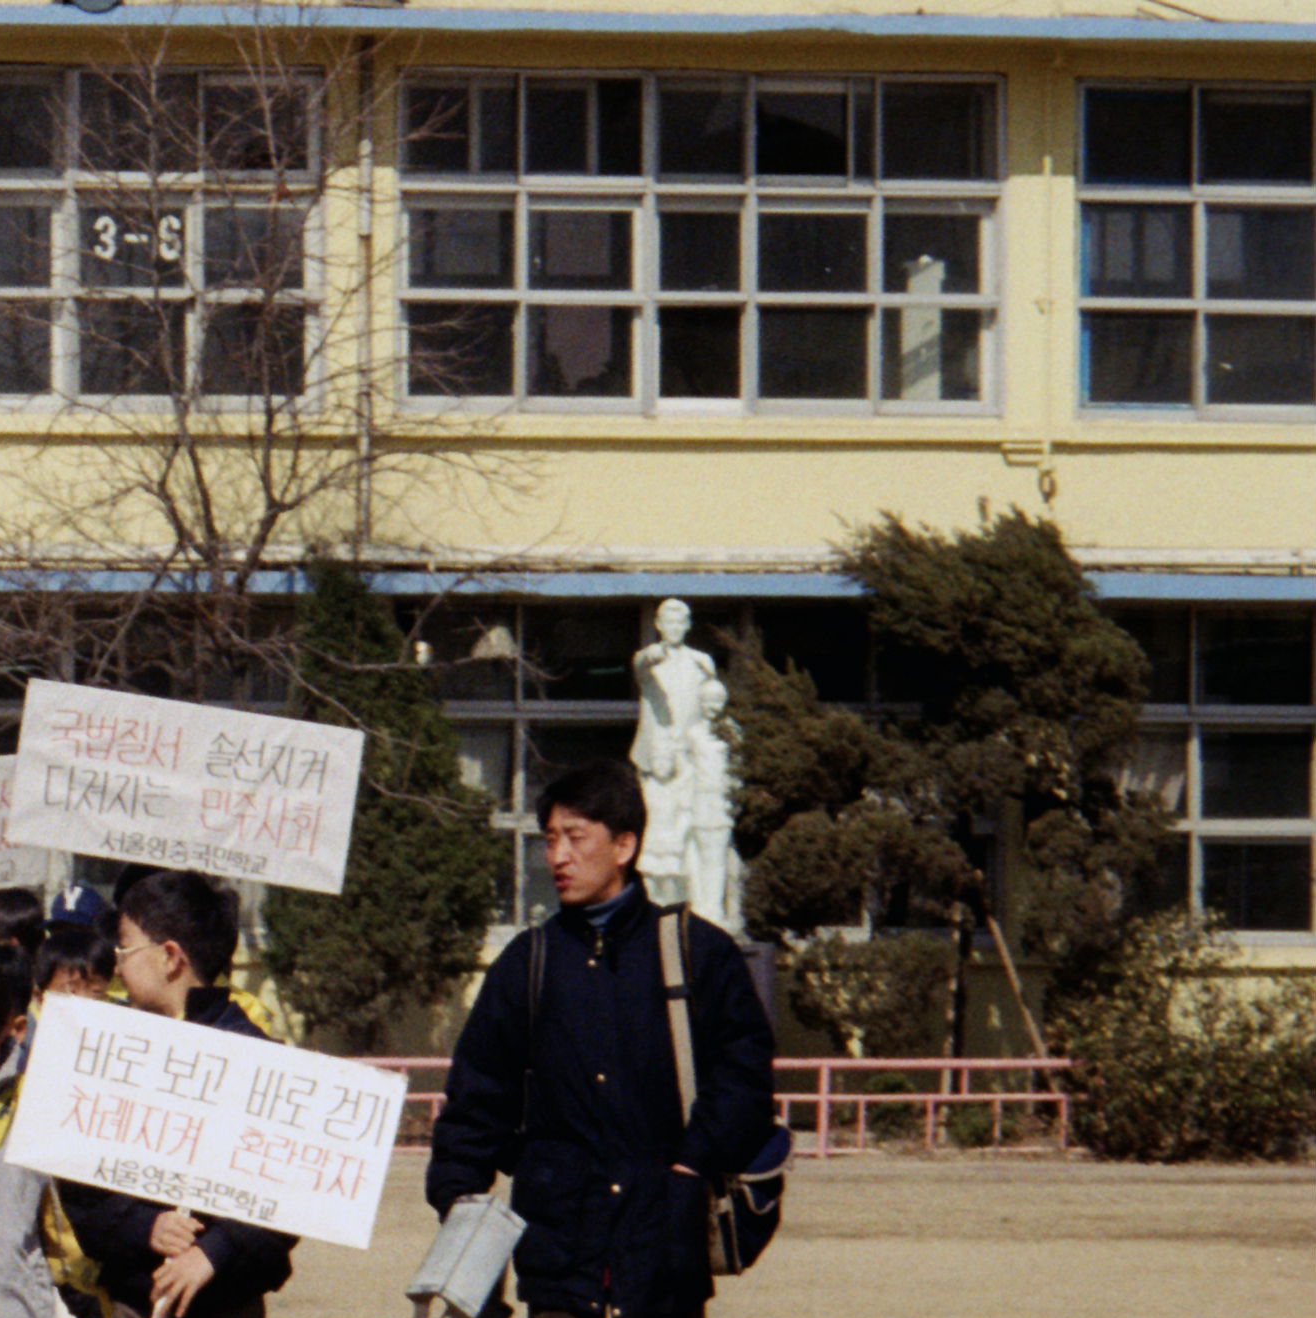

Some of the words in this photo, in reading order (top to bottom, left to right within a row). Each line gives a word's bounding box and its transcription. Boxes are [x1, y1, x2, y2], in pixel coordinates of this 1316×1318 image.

[93, 214, 183, 262] 3-6
[50, 708, 185, 772] 국법질서
[204, 731, 331, 794] 솔선지켜
[43, 763, 173, 819] 다져지는
[198, 787, 324, 857] 민주사회
[73, 1026, 152, 1089] 바로
[155, 1043, 229, 1107] 보고
[245, 1065, 319, 1131] 바로
[323, 1084, 393, 1148] 걷기
